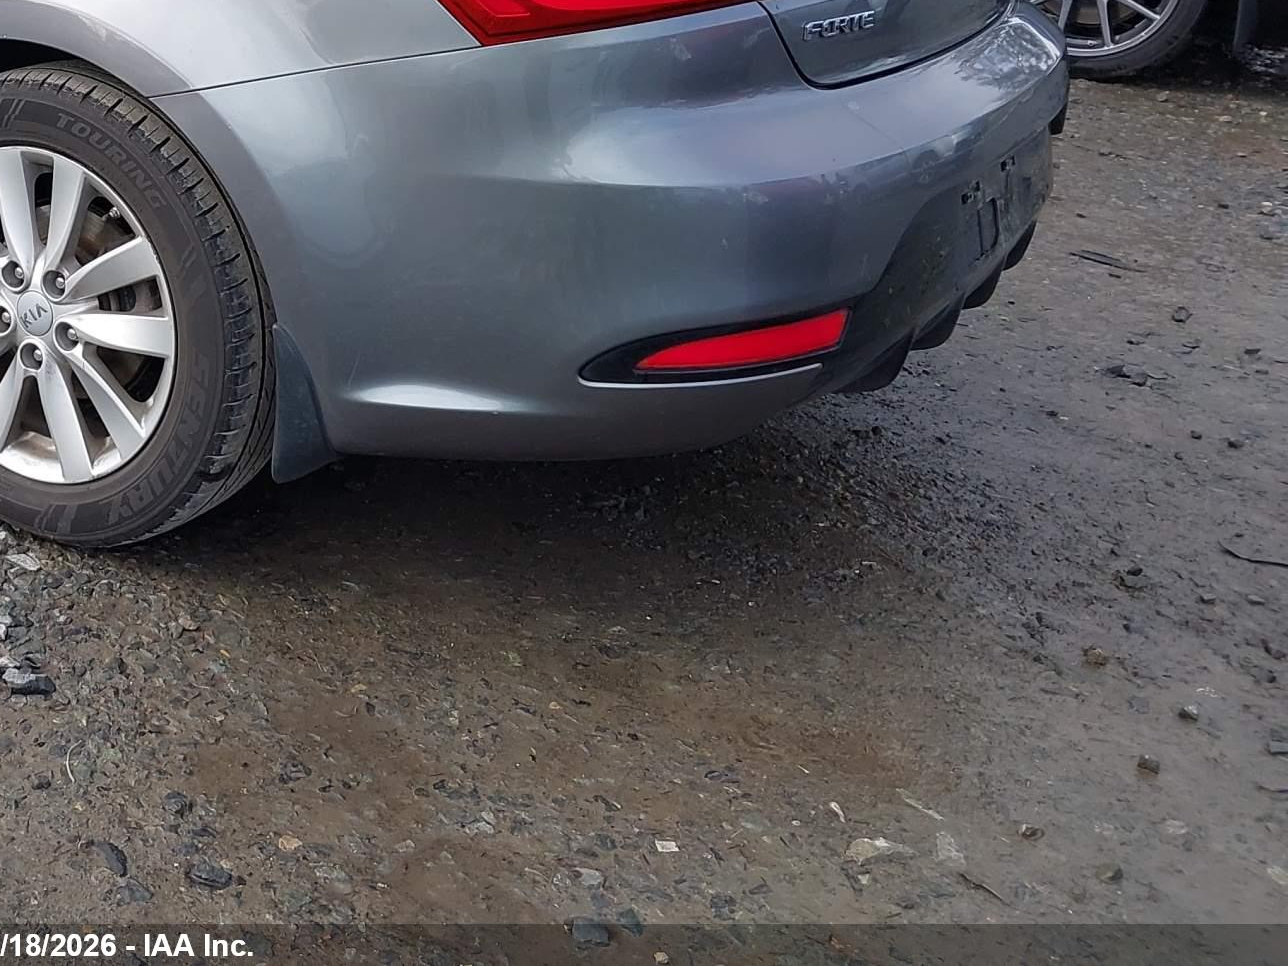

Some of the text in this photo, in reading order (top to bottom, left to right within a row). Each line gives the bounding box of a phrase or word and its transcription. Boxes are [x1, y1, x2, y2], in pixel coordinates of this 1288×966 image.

[801, 10, 875, 41] FORTE
[56, 112, 167, 209] TOURING
[20, 303, 48, 329] KIA
